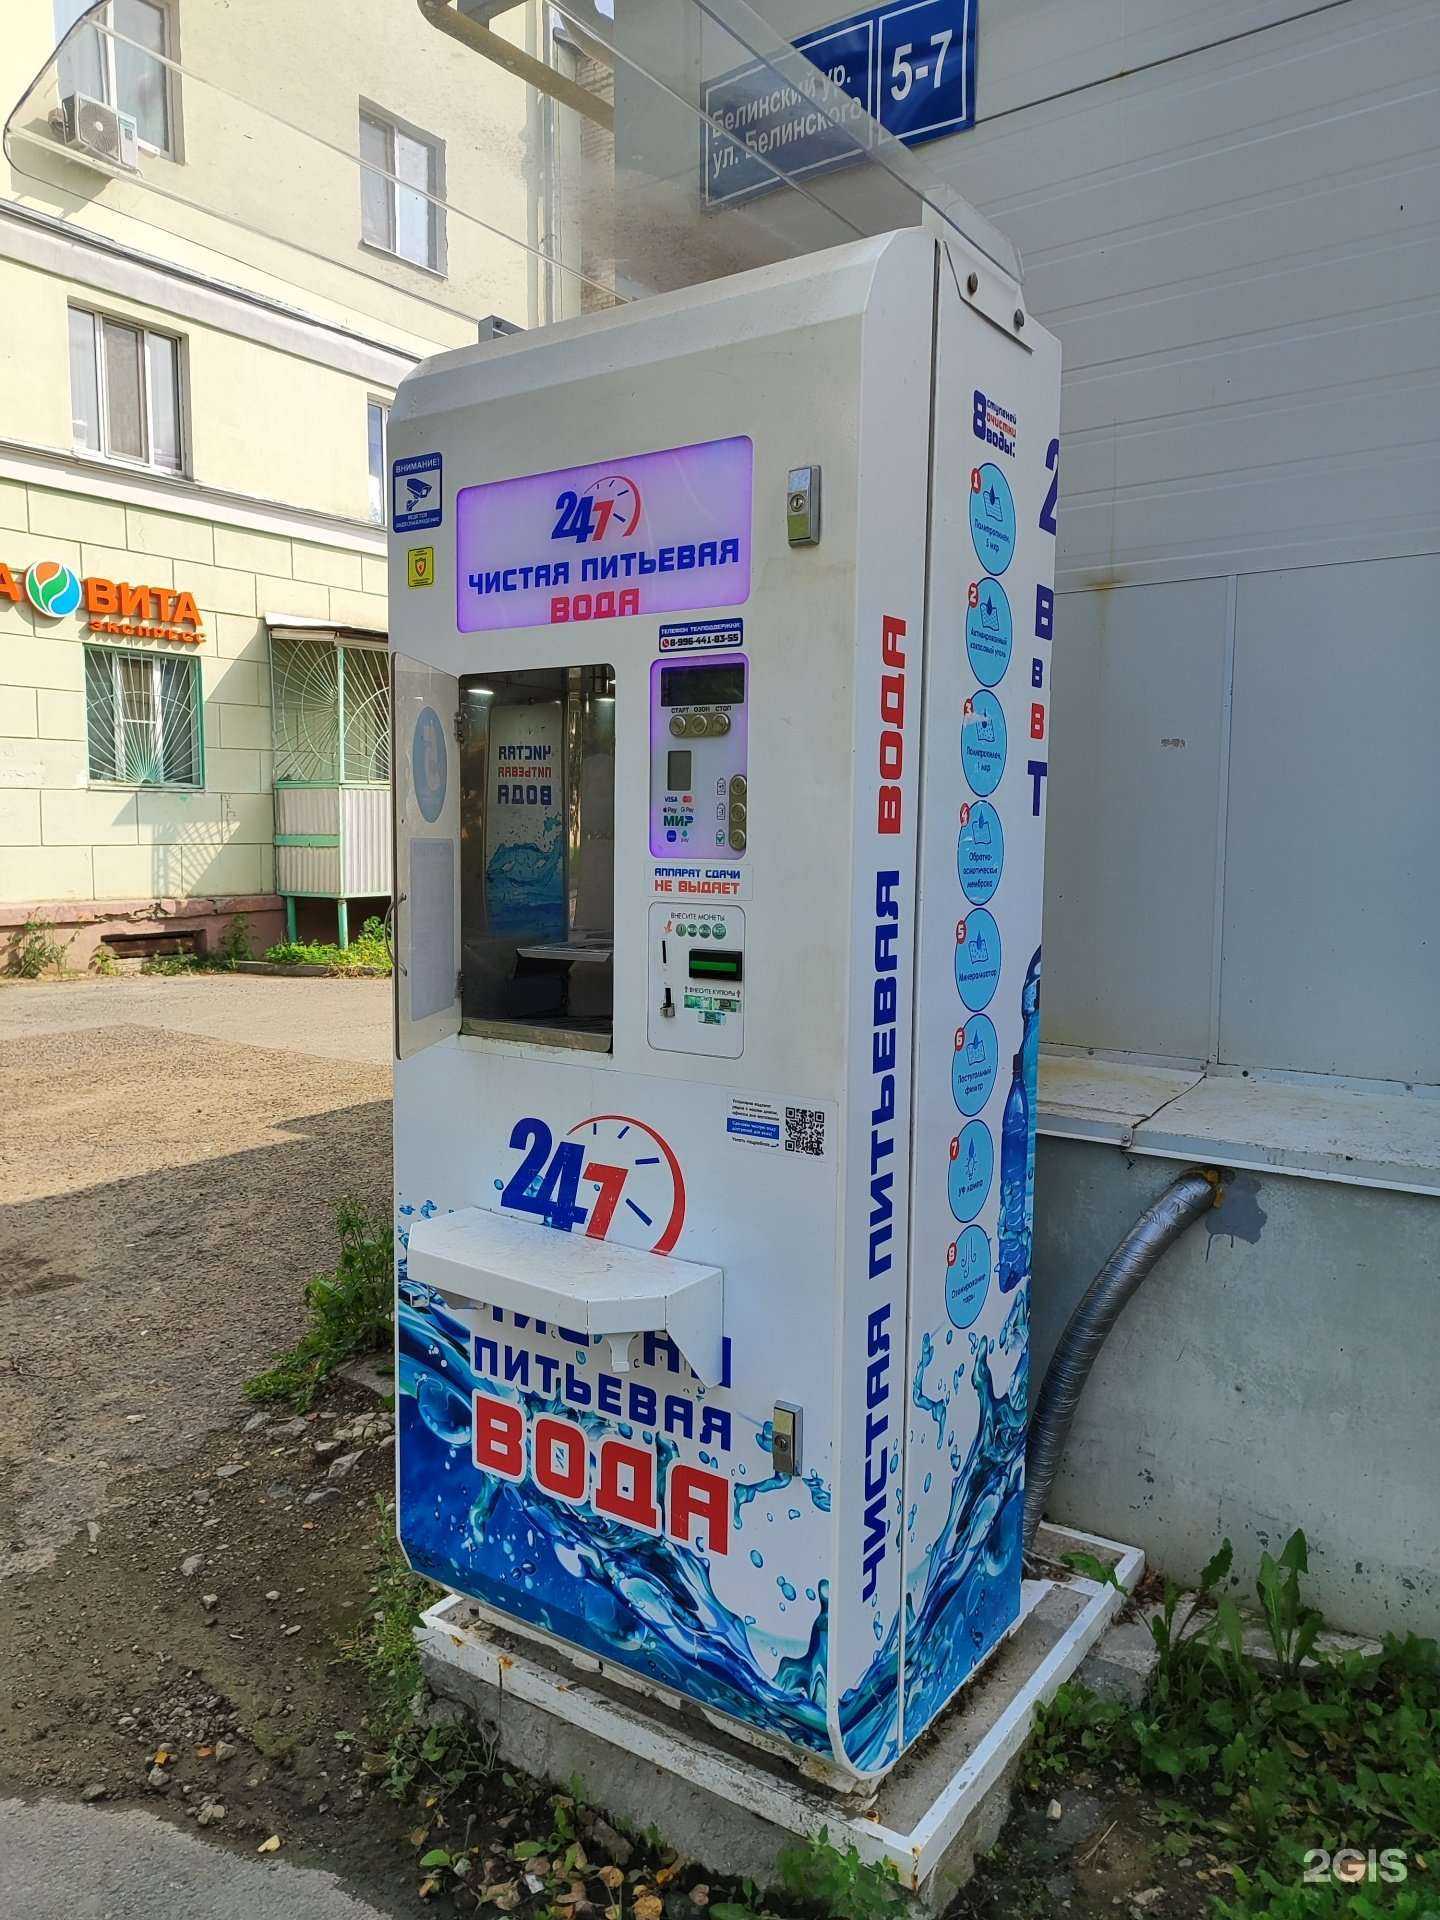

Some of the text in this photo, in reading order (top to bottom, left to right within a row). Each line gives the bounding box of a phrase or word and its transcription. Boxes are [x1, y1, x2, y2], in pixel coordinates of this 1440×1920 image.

[891, 29, 953, 101] 5-7
[712, 62, 851, 138] Белинский ур.
[713, 97, 862, 179] ул. Белинского
[973, 390, 986, 440] 8
[987, 413, 1016, 438] очистки
[986, 428, 1016, 457] воды:
[395, 458, 440, 474] ВНИМАНИЕ!
[469, 538, 739, 595] ЧИСТАЯ ПИТЬЕВАЯ
[84, 577, 203, 625] ВИТА
[550, 589, 640, 624] ВОДА
[89, 619, 207, 644] ЭКСПРЕСС
[664, 816, 694, 826] МИР
[655, 868, 740, 879] АППАРАТ СДАЧИ
[655, 880, 740, 895] НЕ ВЫДАЕТ
[671, 912, 725, 922] ВНЕСИТЕ МОНЕТЫ
[863, 615, 906, 1603] ЧИСТАЯ ПИТЬЕВАЯ ВОДА
[474, 1336, 731, 1452] ПИТЬЕВАЯ
[475, 1395, 729, 1557] ВОДА
